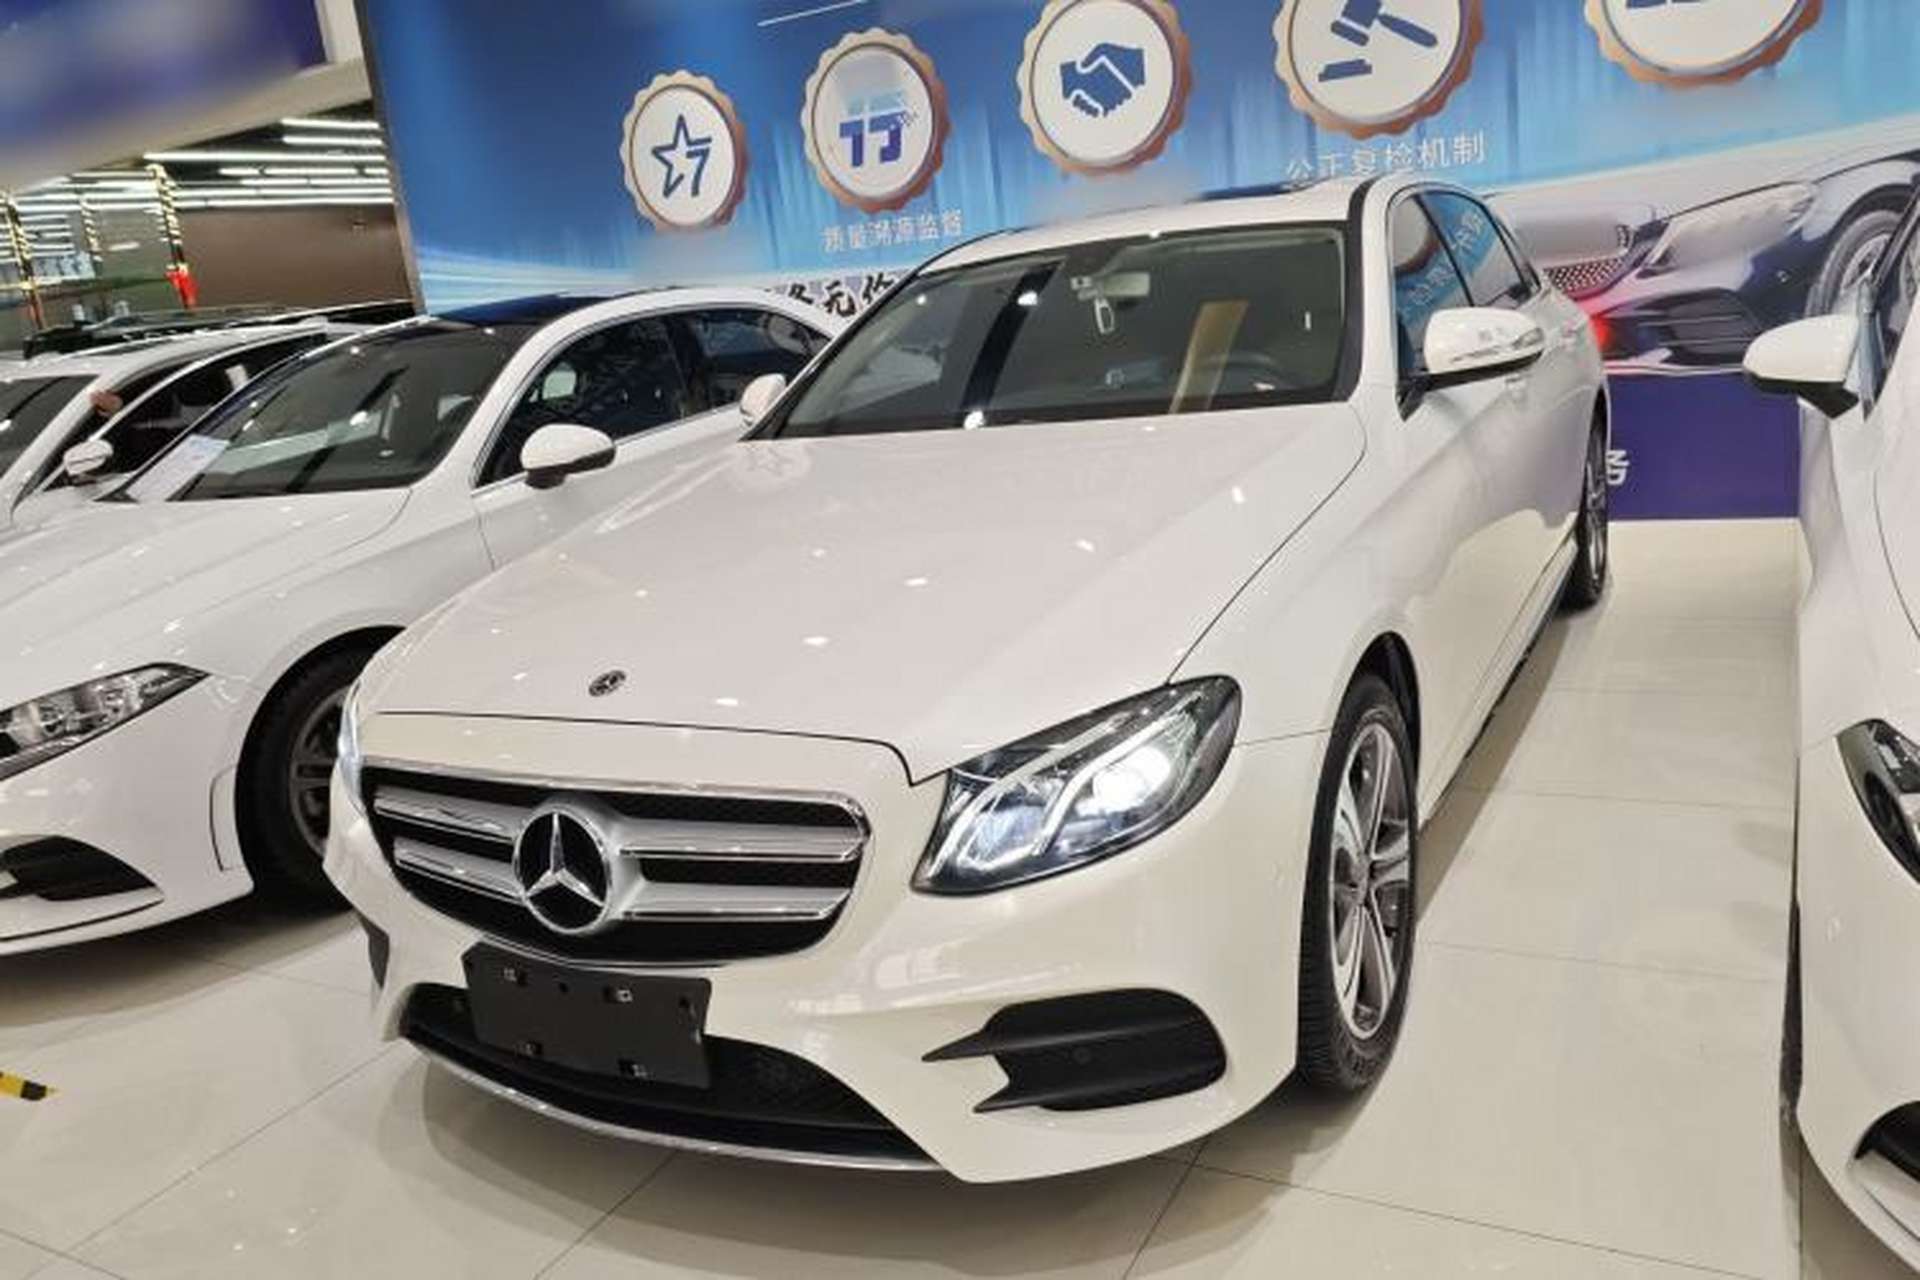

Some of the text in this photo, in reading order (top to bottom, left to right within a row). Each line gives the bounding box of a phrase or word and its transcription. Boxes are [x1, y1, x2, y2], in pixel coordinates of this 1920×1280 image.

[1287, 130, 1485, 181] 公正复检机制
